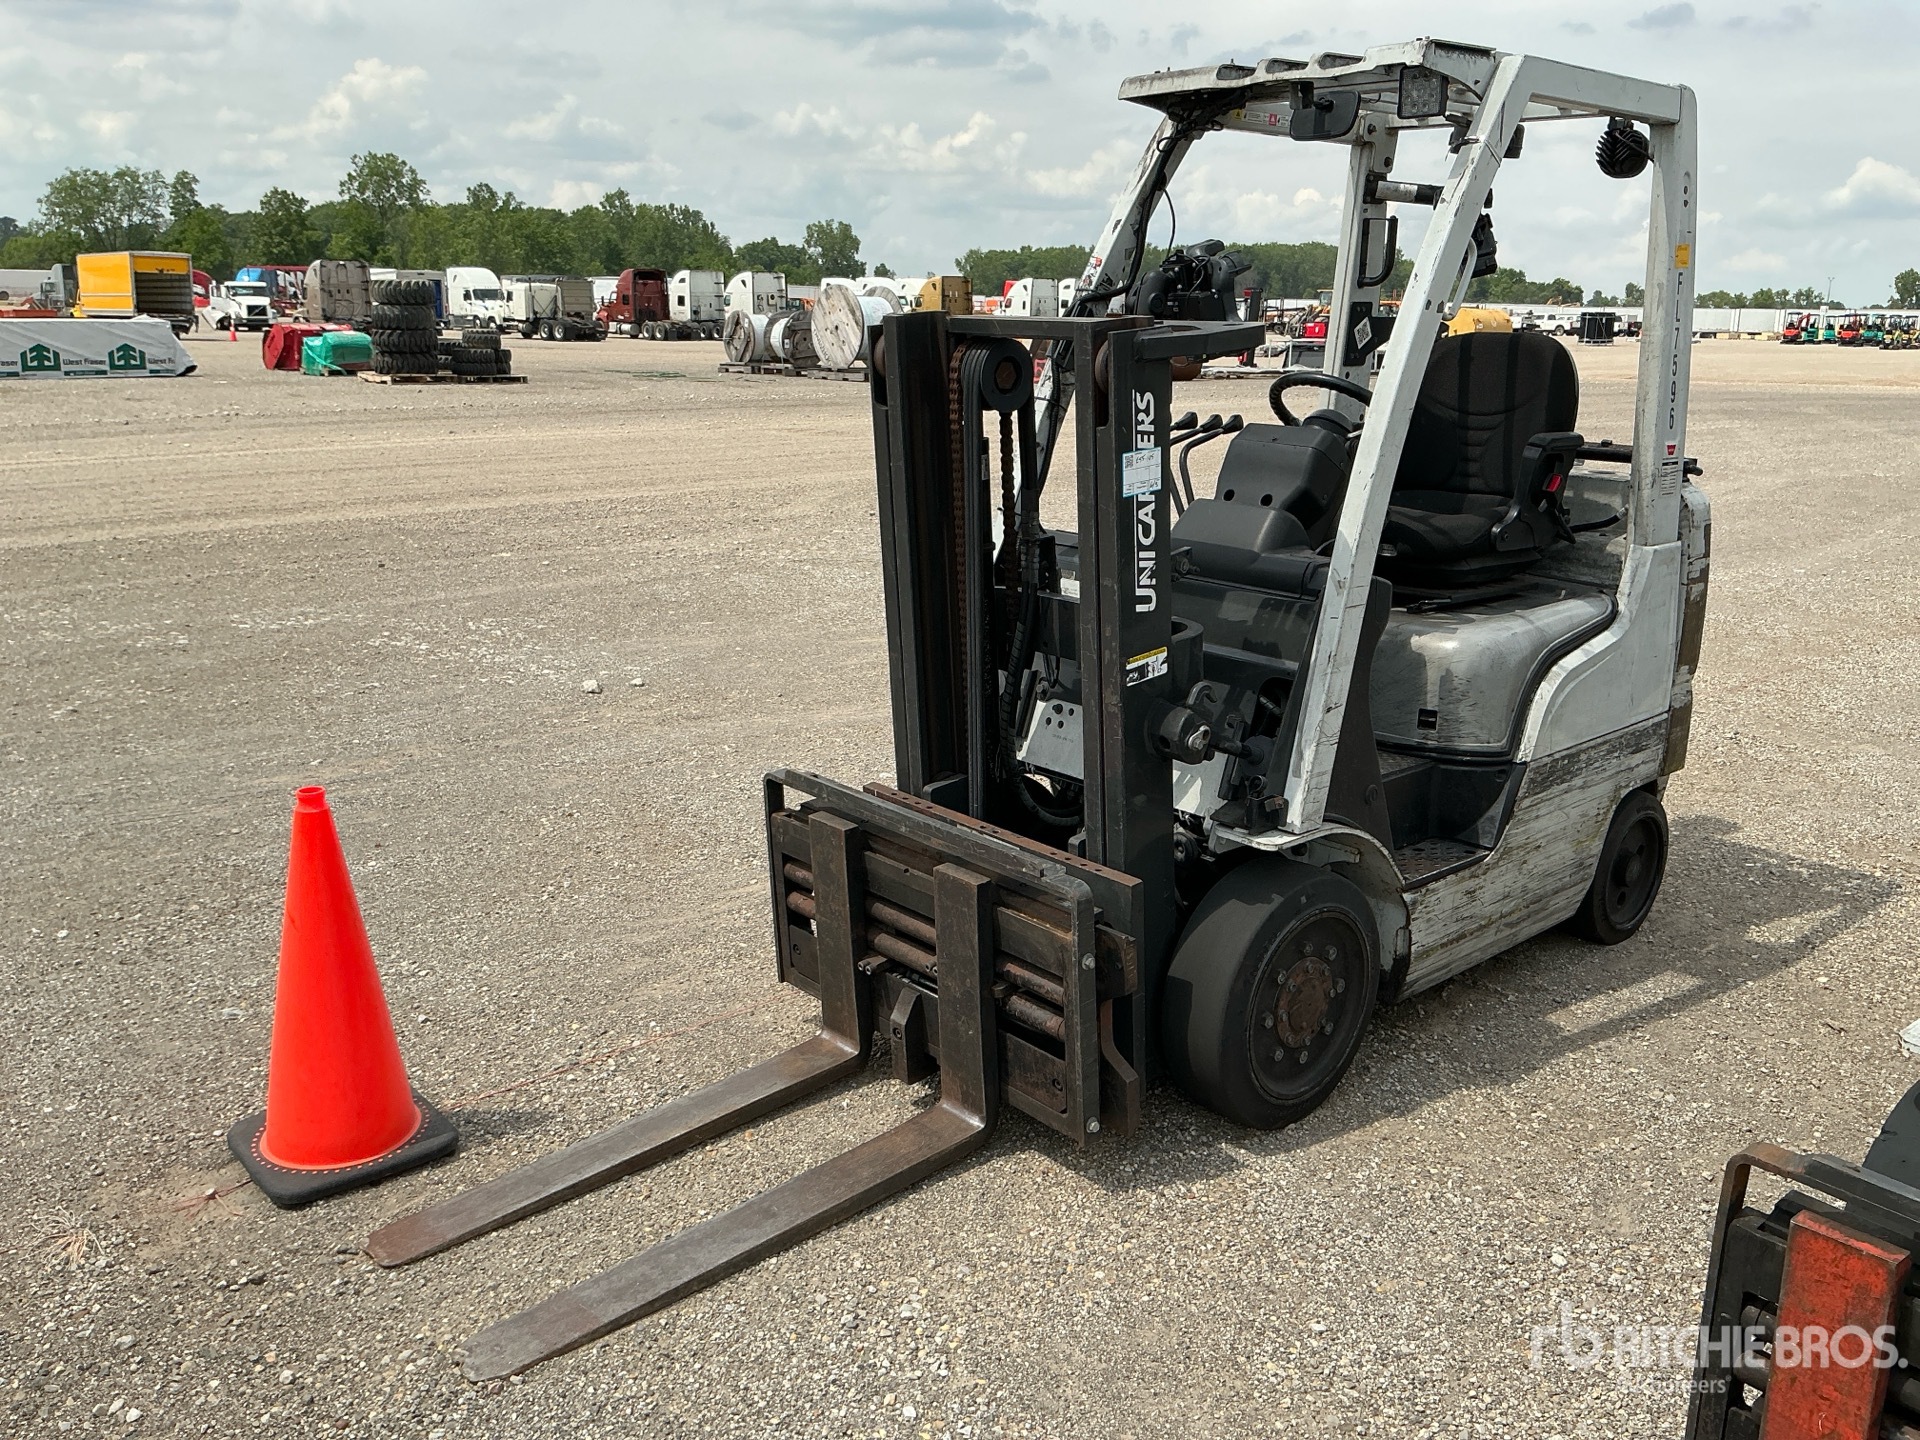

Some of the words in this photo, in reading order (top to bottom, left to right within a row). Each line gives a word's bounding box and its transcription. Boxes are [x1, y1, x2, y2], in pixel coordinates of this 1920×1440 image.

[62, 358, 82, 366] West
[84, 358, 106, 366] Fraser
[1668, 271, 1684, 430] FL7596
[1135, 391, 1157, 612] UNICAERS
